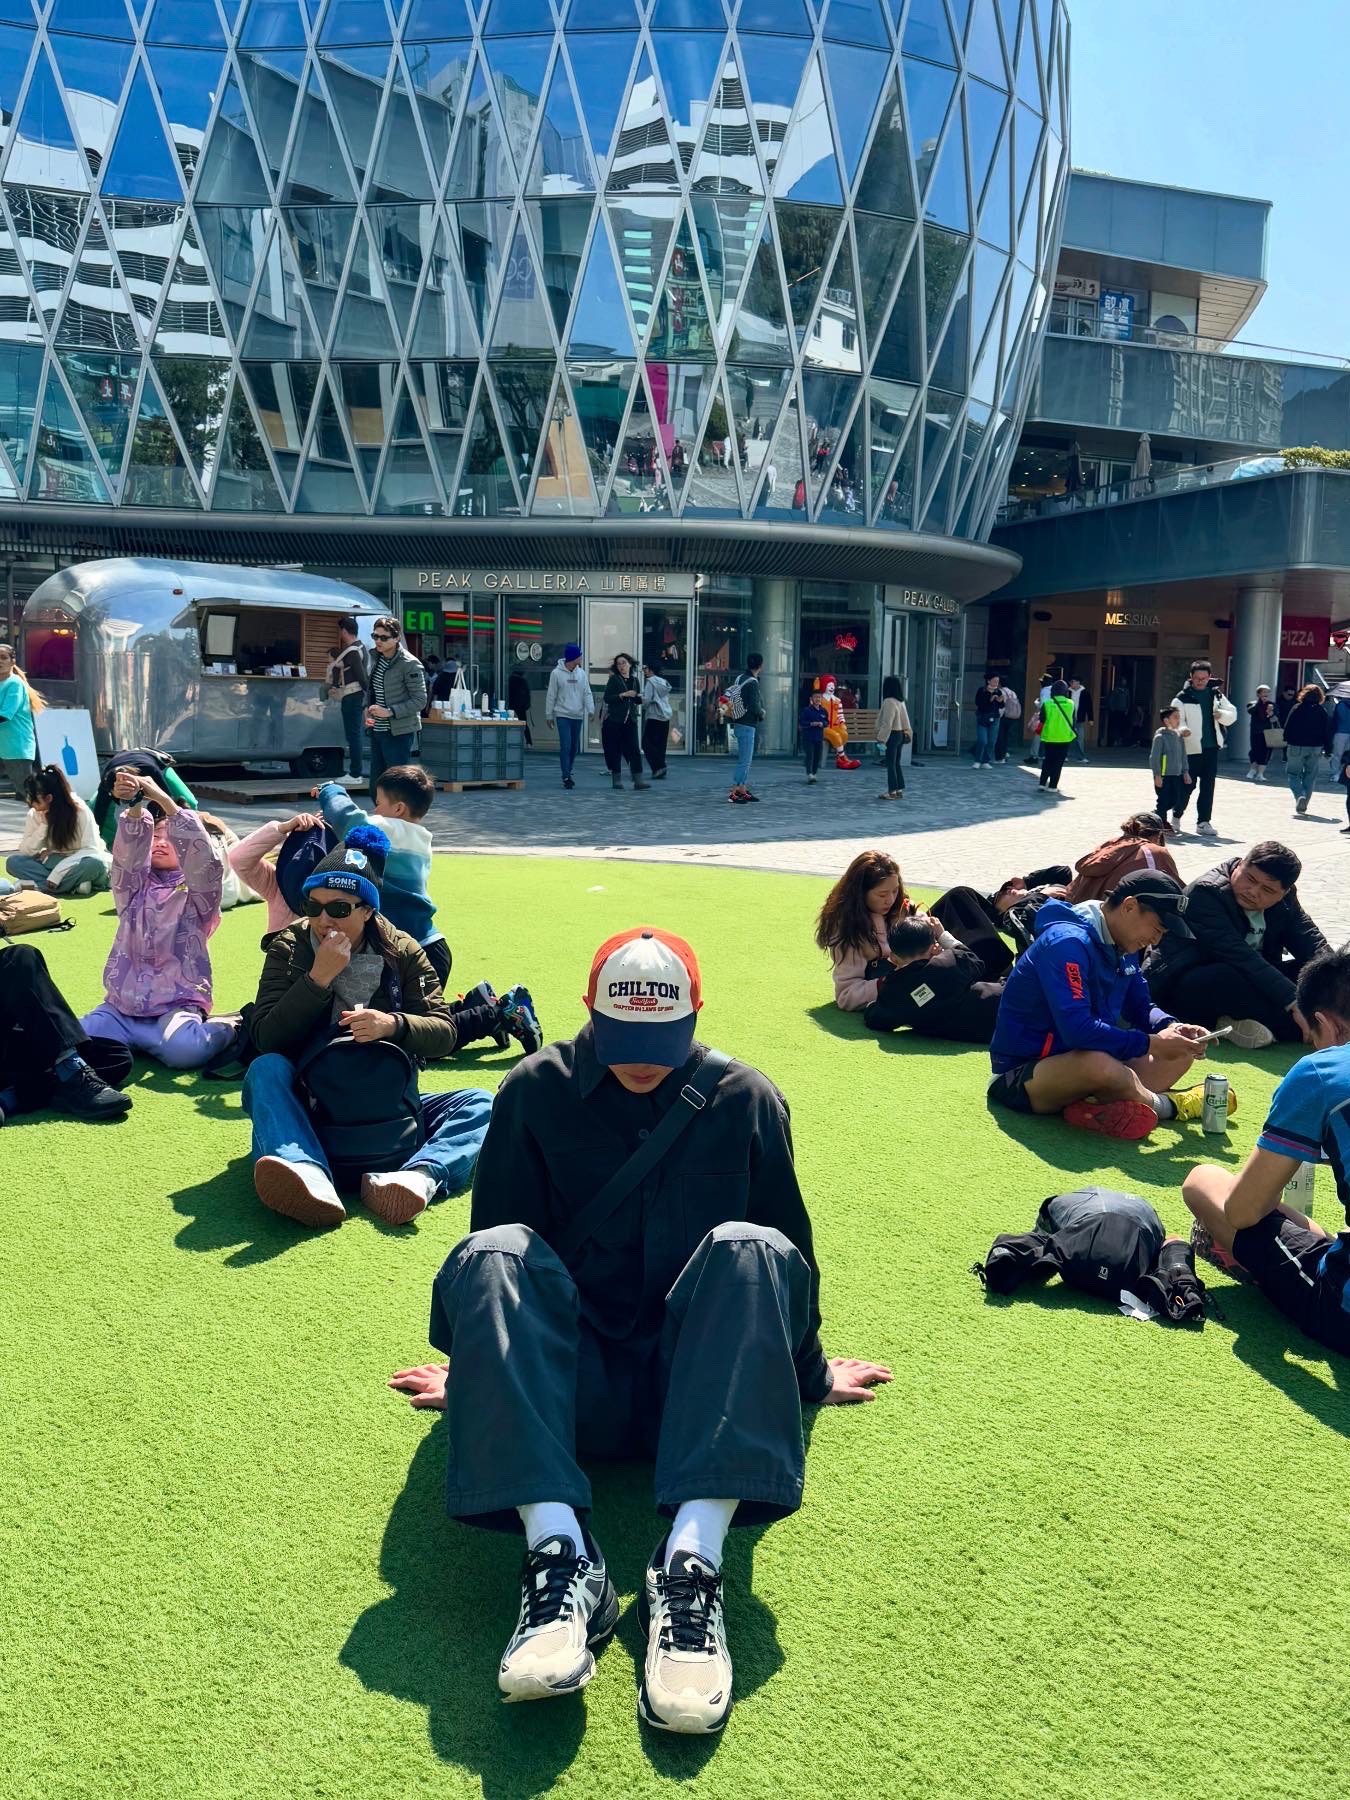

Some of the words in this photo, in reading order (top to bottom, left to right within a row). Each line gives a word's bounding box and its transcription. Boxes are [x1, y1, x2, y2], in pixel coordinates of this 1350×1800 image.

[418, 572, 472, 588] PEAK
[484, 573, 591, 591] GALLERIA
[601, 575, 666, 591] 山頂廣場
[903, 590, 932, 608] PEAK
[1105, 612, 1160, 626] MESSINA
[1281, 630, 1315, 648] PIZZA
[328, 877, 357, 887] SONIC
[608, 980, 680, 1001] CHILTON
